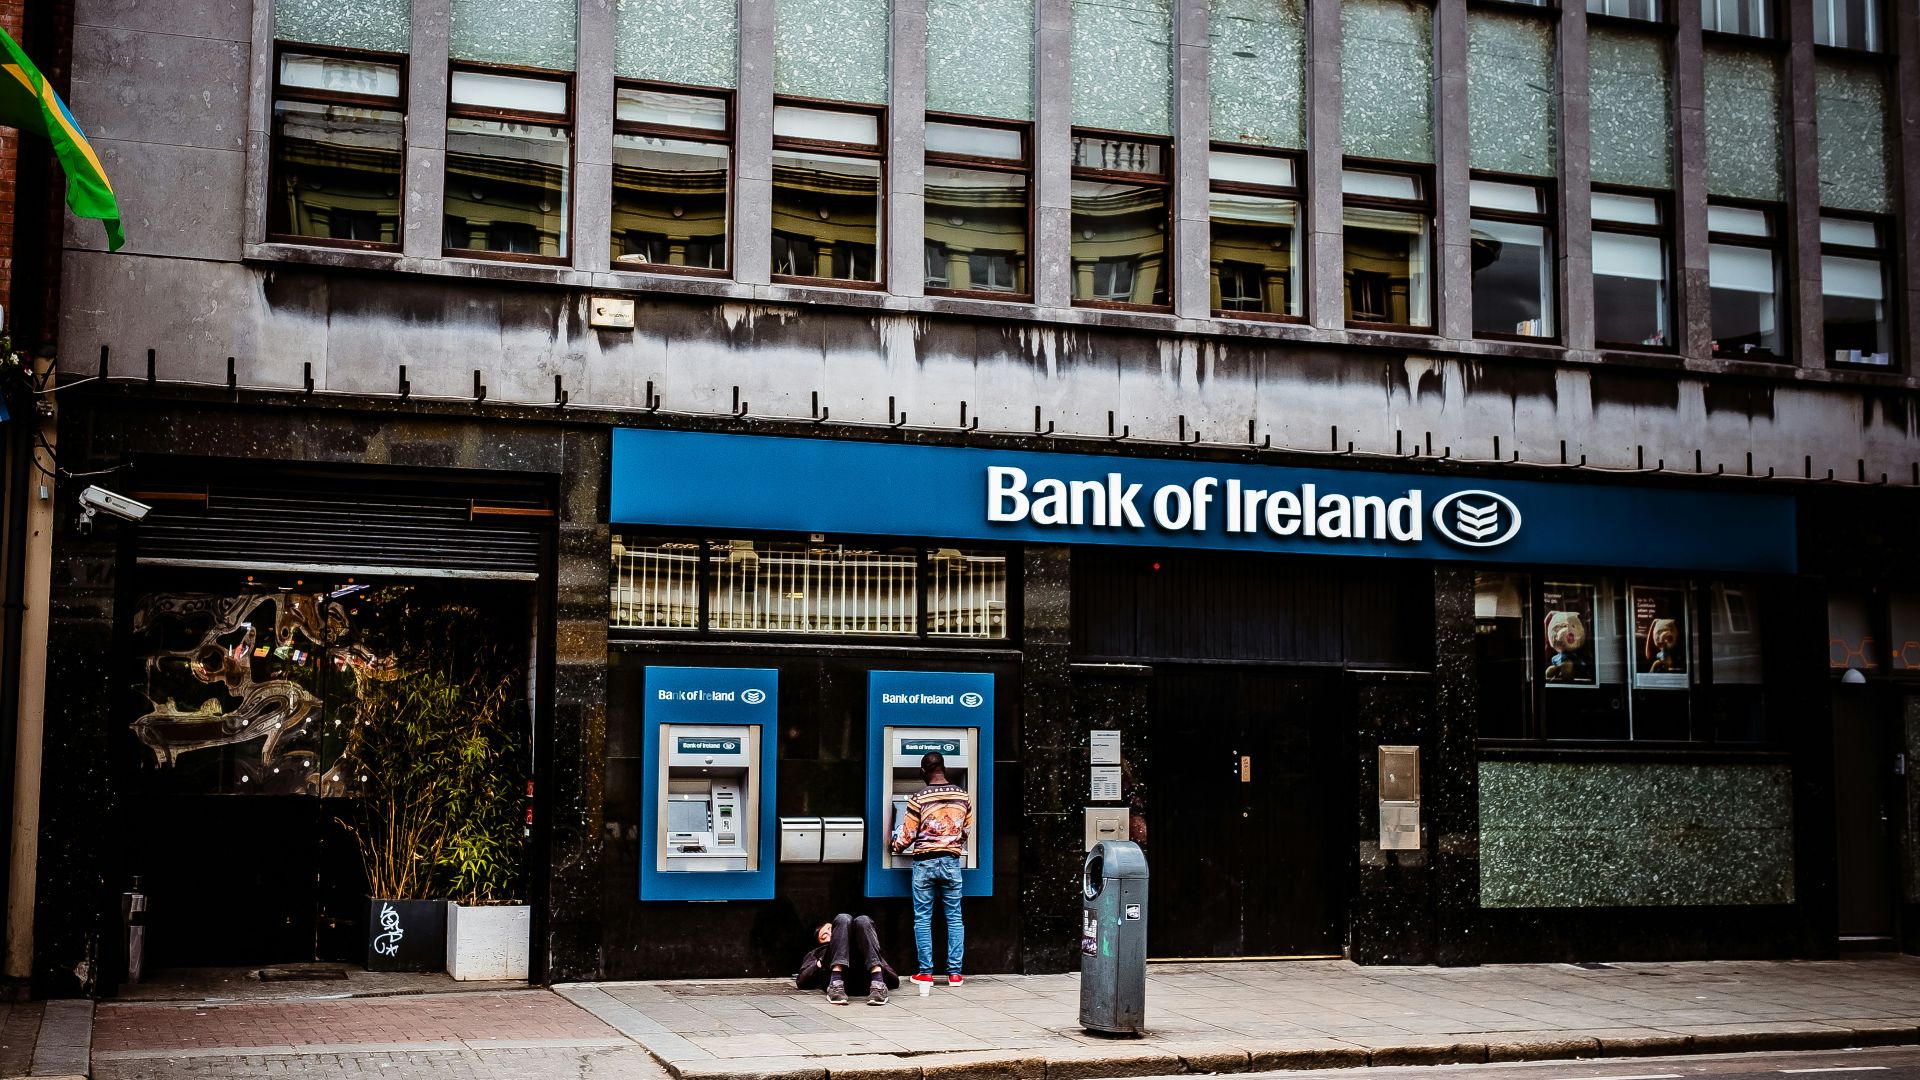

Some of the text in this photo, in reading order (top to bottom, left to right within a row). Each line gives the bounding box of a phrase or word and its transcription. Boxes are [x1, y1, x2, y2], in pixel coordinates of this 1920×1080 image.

[987, 465, 1423, 541] Bank of Ireland
[658, 689, 735, 702] Bank of Ireland
[882, 693, 954, 705] Bank of Ireland
